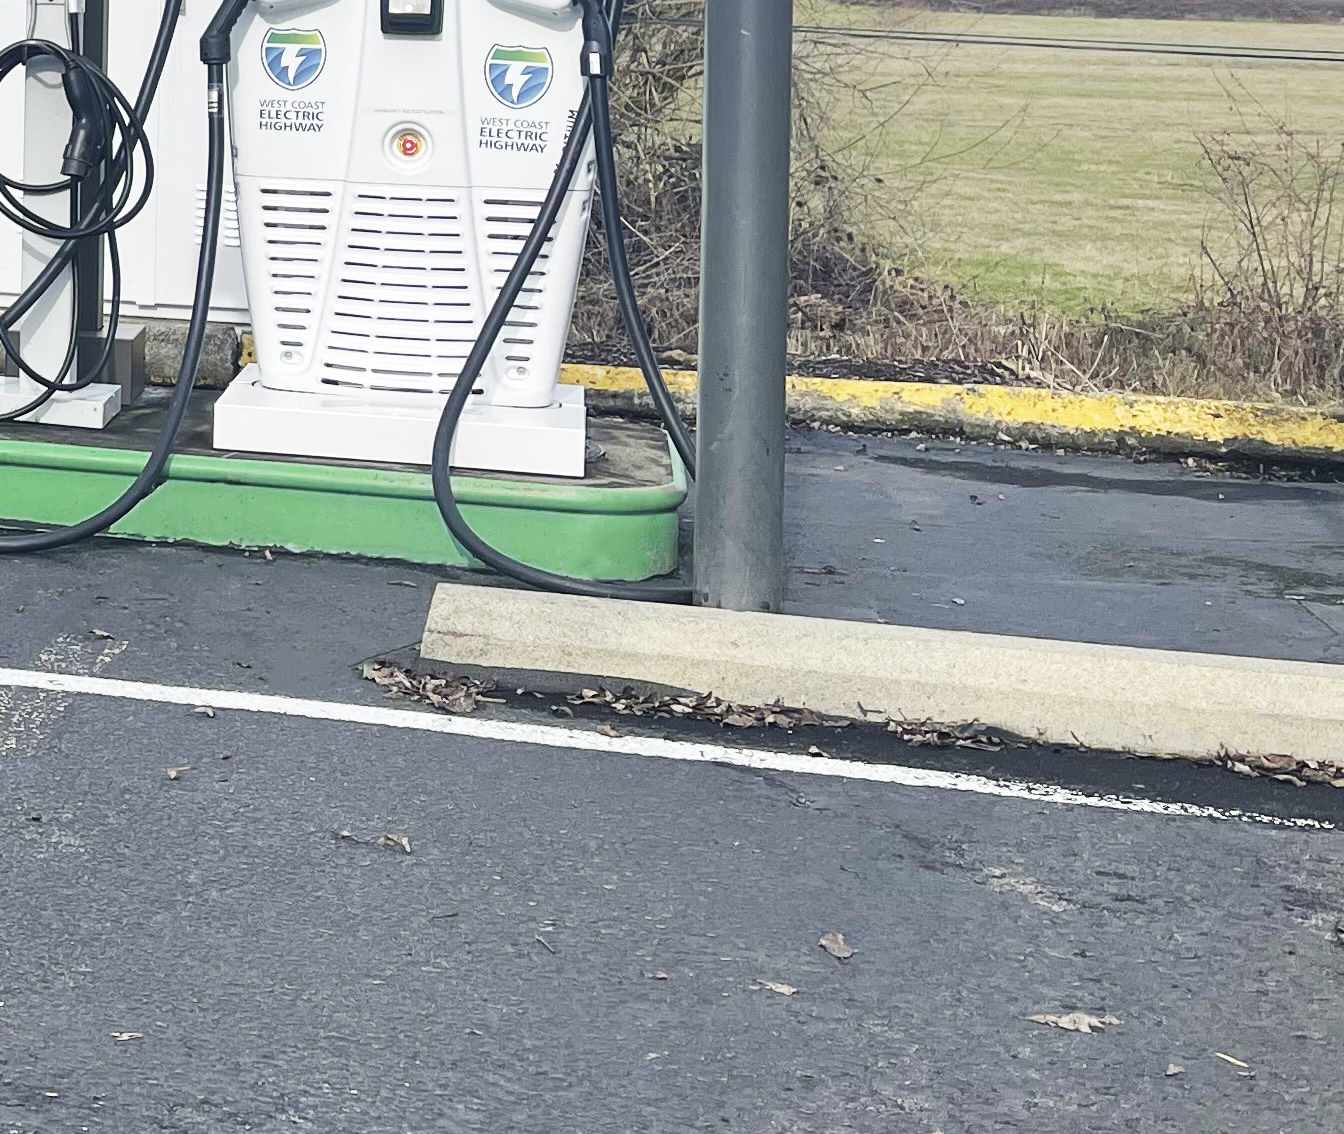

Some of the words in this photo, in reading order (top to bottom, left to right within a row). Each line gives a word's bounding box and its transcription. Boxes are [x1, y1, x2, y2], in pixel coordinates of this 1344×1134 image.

[259, 98, 288, 109] WEST
[291, 100, 326, 111] COAST
[259, 109, 325, 122] ELECTRIC
[259, 120, 325, 133] HIGHWAY
[480, 116, 511, 127] WEST
[513, 119, 551, 131] COAST
[479, 126, 549, 142] ELECTRIC
[478, 139, 548, 154] HIGHWAY
